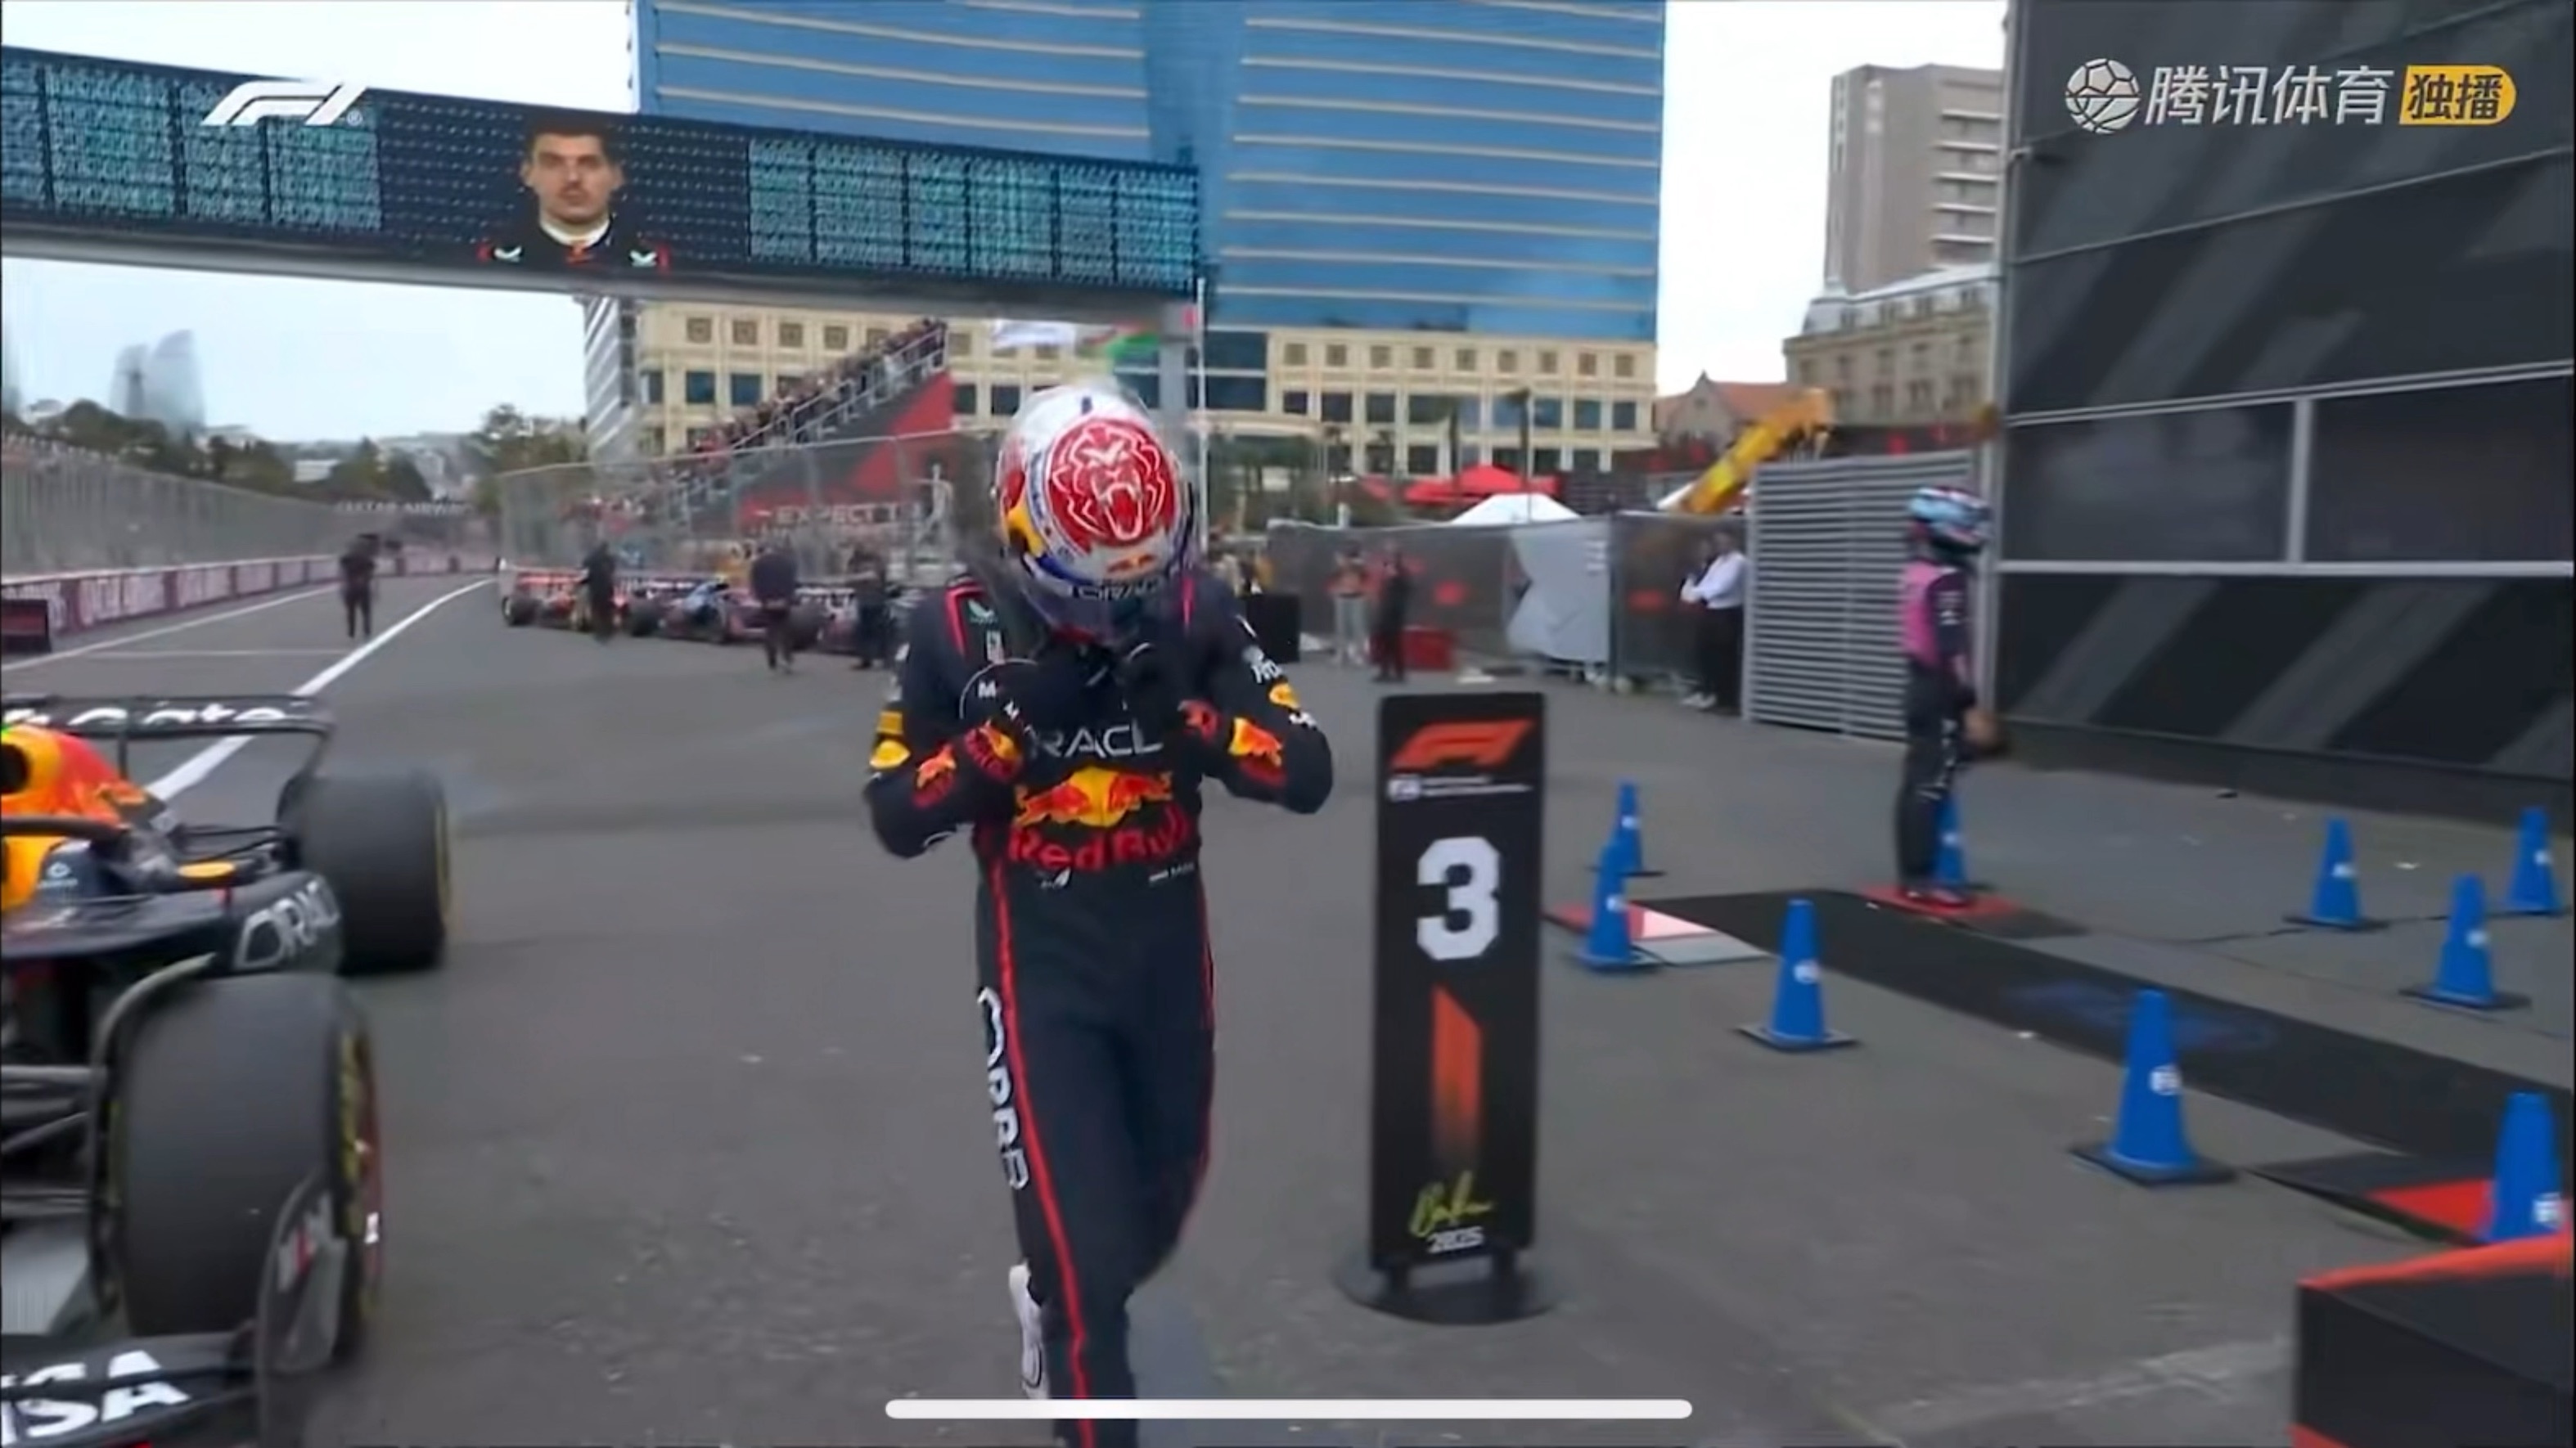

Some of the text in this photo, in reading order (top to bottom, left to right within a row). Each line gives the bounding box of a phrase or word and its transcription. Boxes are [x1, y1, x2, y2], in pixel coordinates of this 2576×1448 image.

[1025, 717, 1164, 758] RACL
[1008, 802, 1190, 871] Red Bull
[1416, 836, 1500, 960] 3
[1426, 1225, 1484, 1254] 2025
